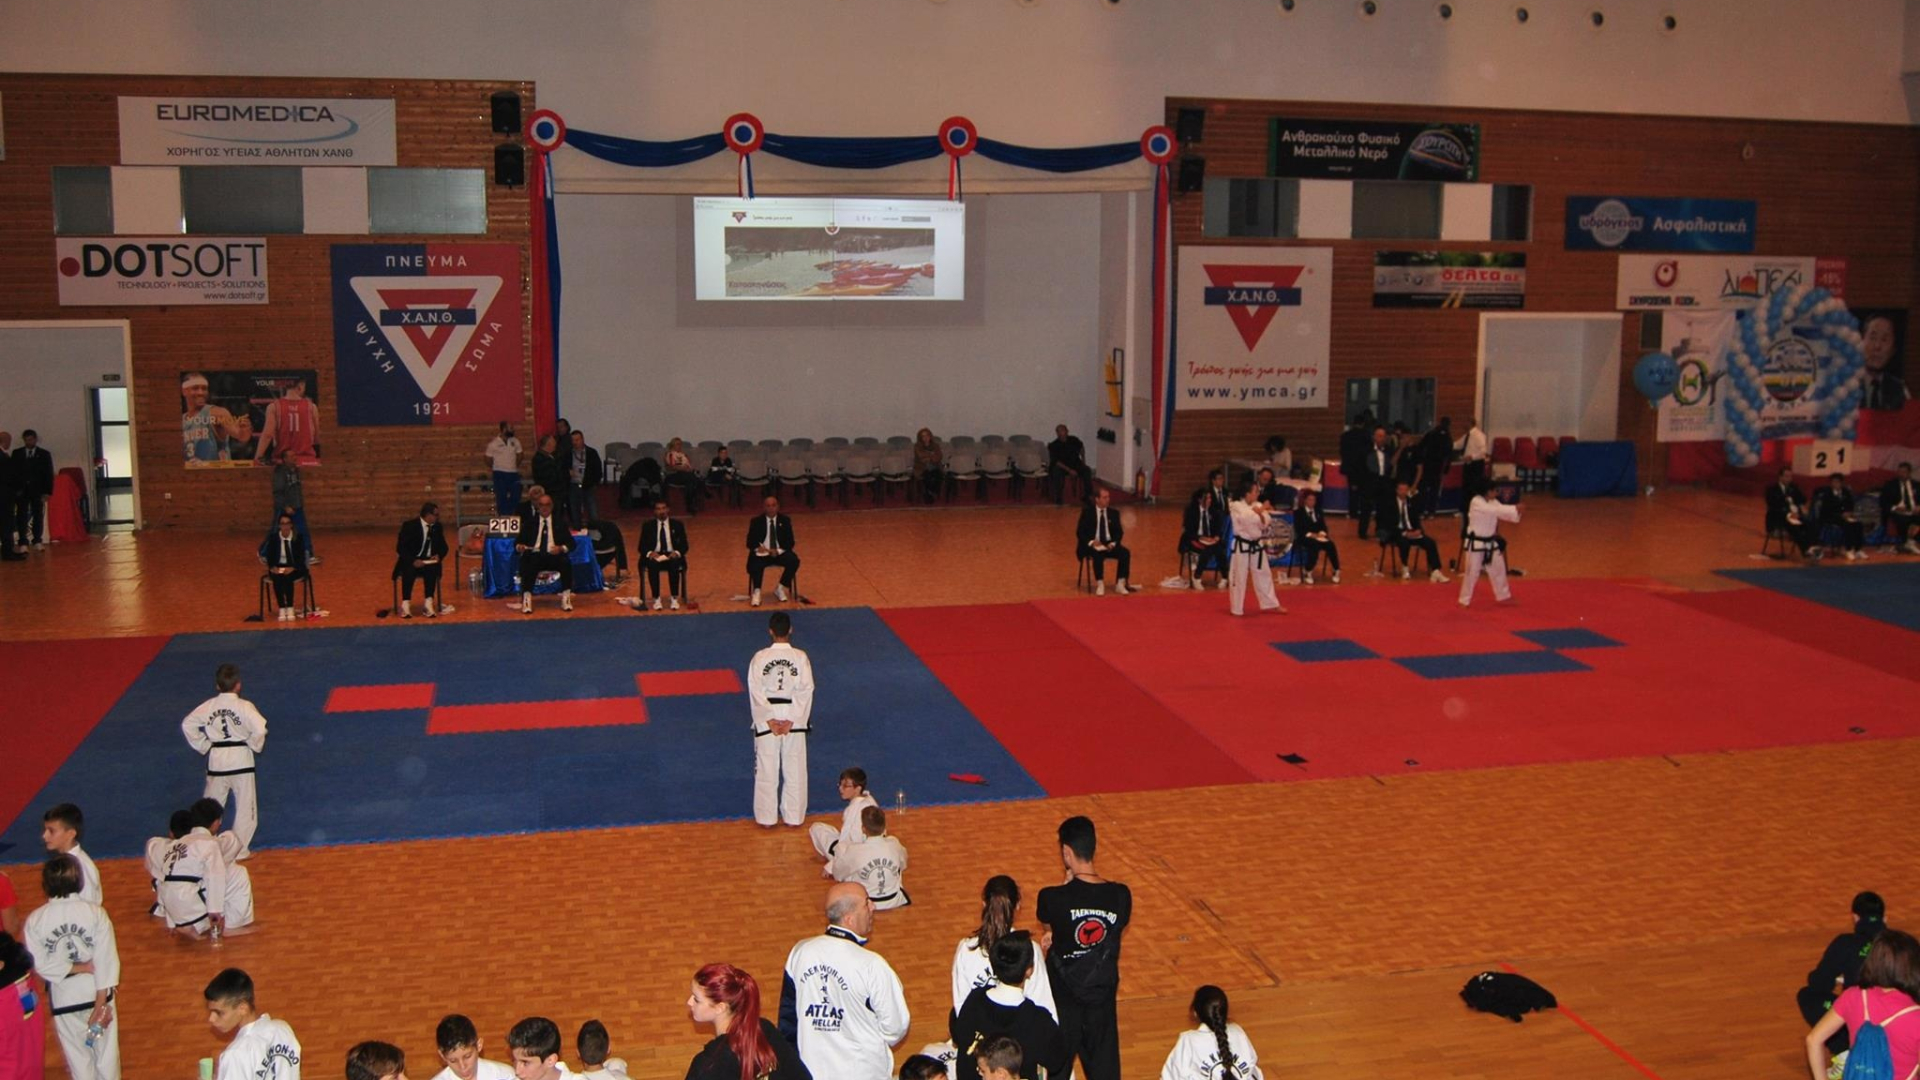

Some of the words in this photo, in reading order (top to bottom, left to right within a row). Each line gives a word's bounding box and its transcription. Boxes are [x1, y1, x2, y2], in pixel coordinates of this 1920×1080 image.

[167, 147, 220, 157] ΧΟΡΗΓΟΣ
[223, 147, 262, 157] ΥΓΕΙΑΣ
[265, 147, 319, 158] ΑΘΛΗΤΩΝ
[322, 148, 353, 158] ΧΑΝΘ
[1358, 146, 1389, 161] Νερό
[82, 243, 265, 278] DOTSOFT
[385, 255, 468, 268] ΠΝΕΥΜΑ
[117, 281, 171, 290] TECHNOLOGY
[178, 281, 216, 290] PROJECTS
[222, 280, 266, 289] SOLUTIONS
[204, 291, 266, 301] www.dotsoft.gr
[401, 311, 456, 324] Χ.Α.Ν.Θ.
[355, 321, 395, 373] ΨΥΧΗ
[465, 321, 503, 372] ΣΩΜΑ
[1187, 386, 1318, 401] www.ymca.gr
[413, 402, 450, 415] 1921
[491, 519, 519, 532] 218
[804, 1003, 845, 1020] ATLAS
[811, 1018, 842, 1028] HELLAS
